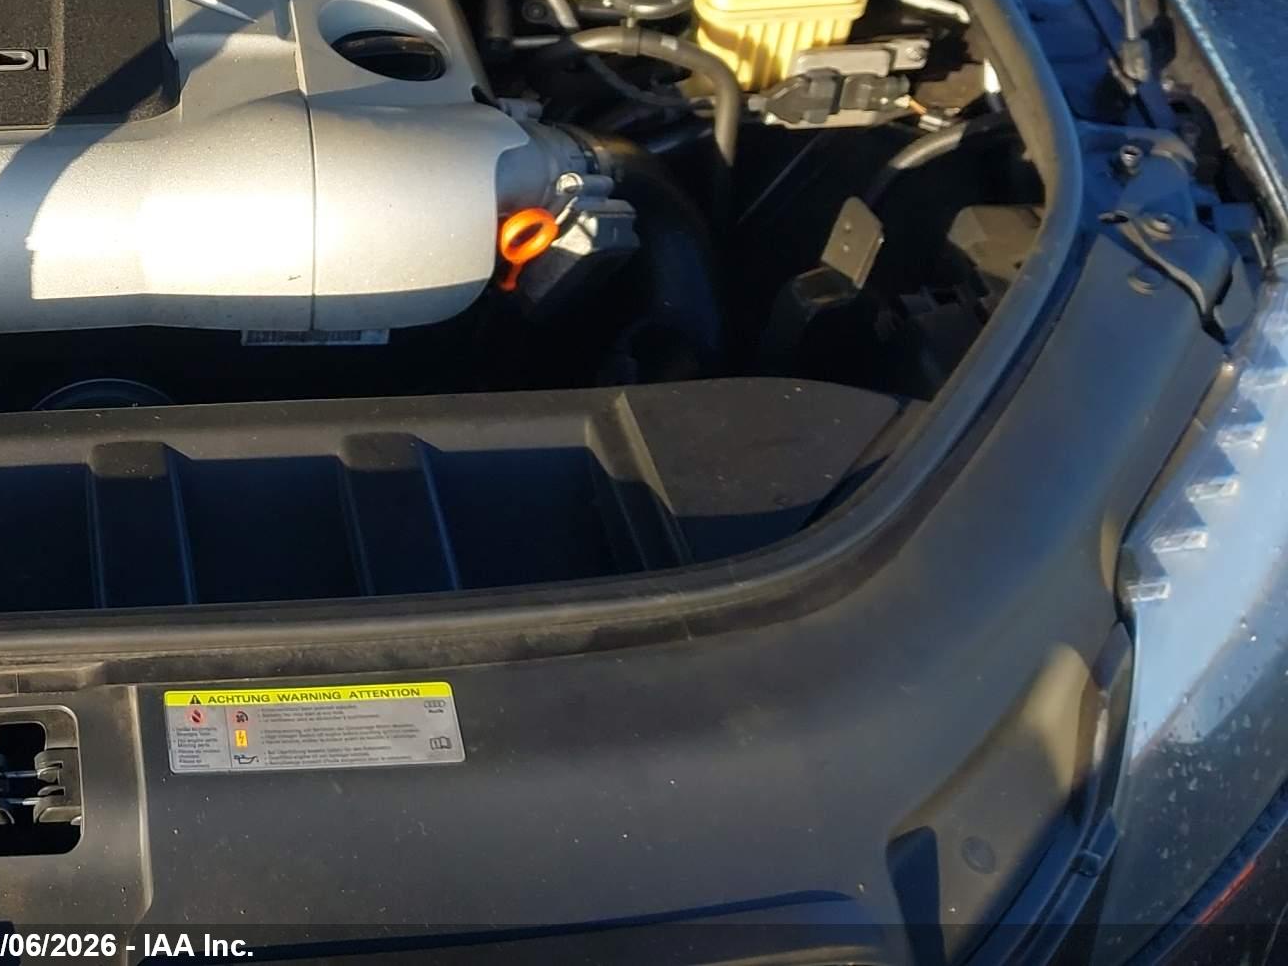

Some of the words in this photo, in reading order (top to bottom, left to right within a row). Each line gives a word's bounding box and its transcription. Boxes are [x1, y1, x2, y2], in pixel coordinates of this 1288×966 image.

[207, 693, 270, 705] ACHTUNG
[276, 690, 343, 703] WARNING
[348, 687, 422, 700] ATTENTION
